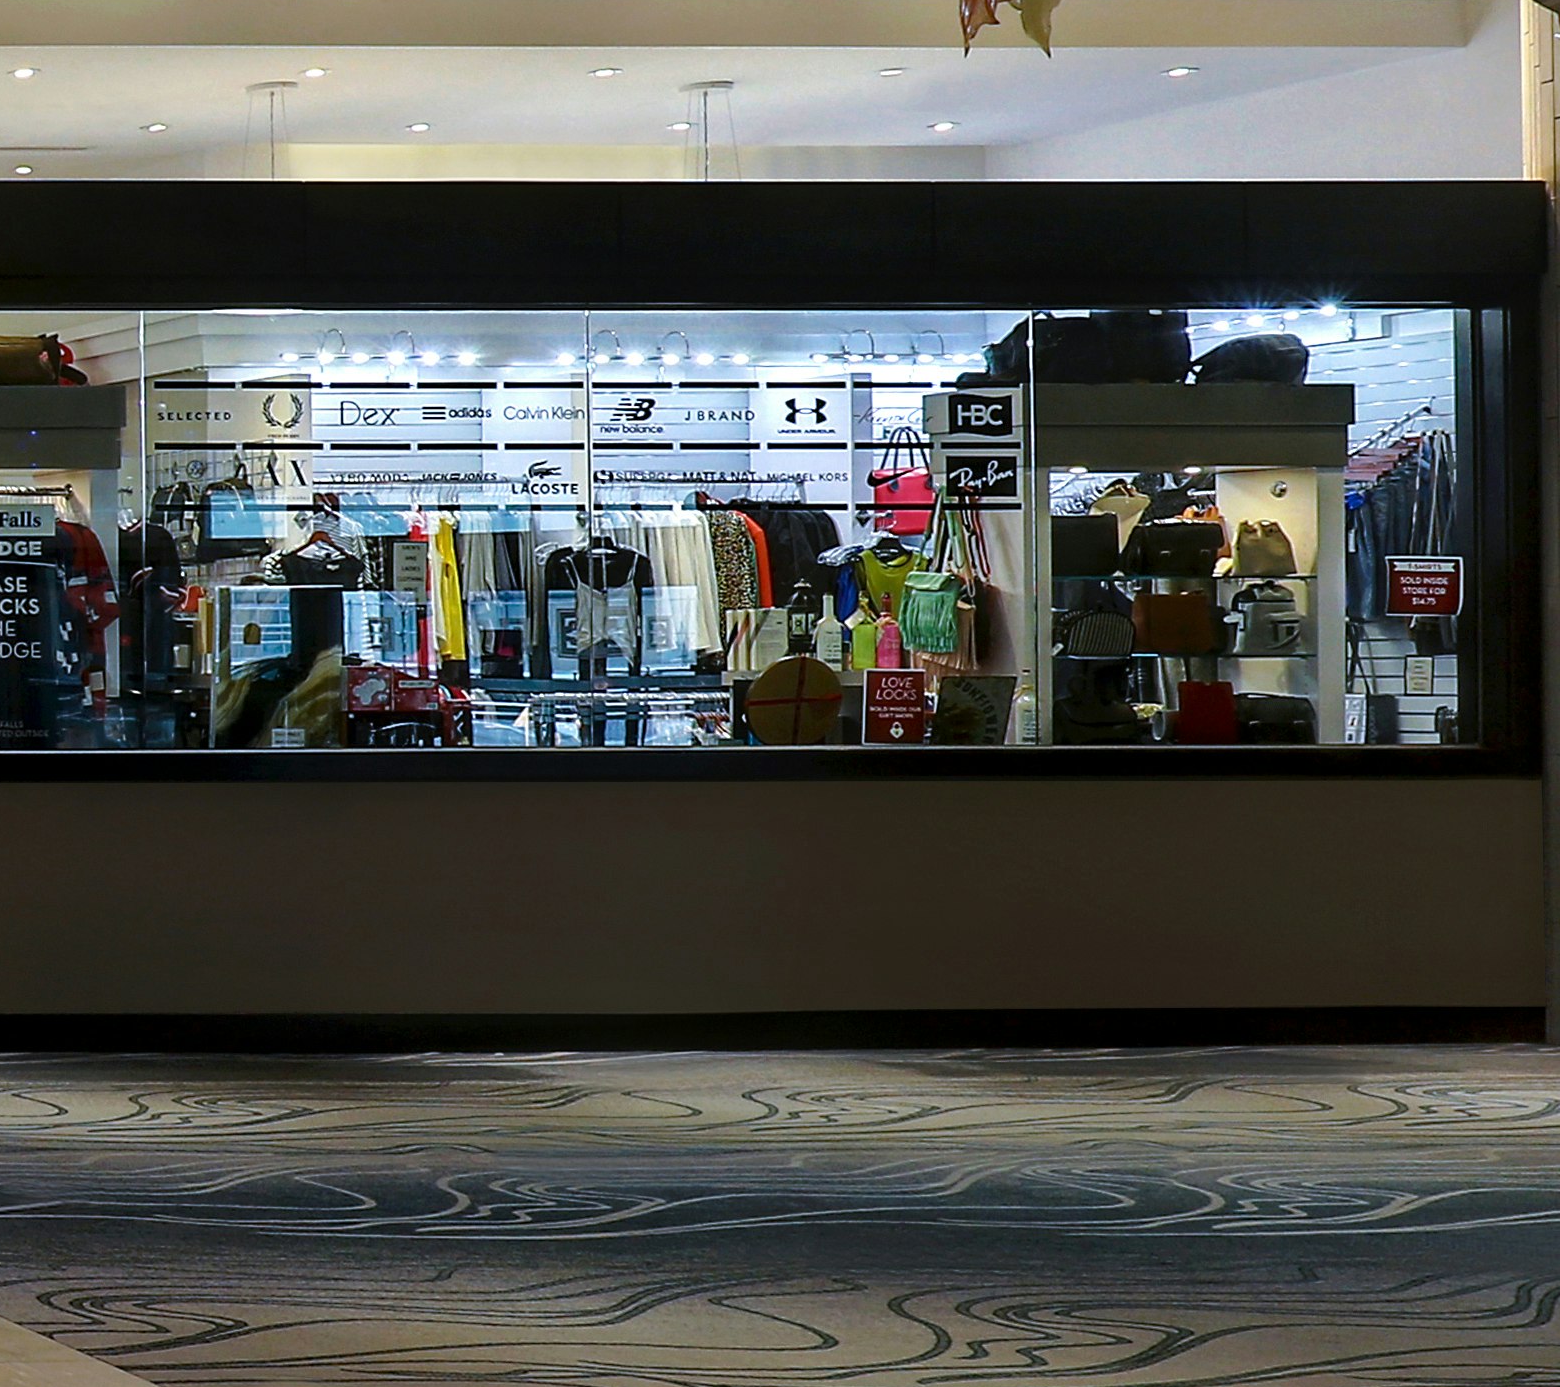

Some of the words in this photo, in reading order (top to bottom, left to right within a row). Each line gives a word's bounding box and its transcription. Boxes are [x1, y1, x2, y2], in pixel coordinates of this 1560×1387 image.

[157, 411, 232, 421] SELECTED
[340, 401, 400, 426] Dex
[448, 406, 492, 418] adidas
[504, 405, 549, 420] Calvin
[552, 405, 585, 420] Klein
[684, 411, 691, 421] J
[698, 411, 755, 421] BRAND
[957, 404, 1004, 426] HBC
[622, 424, 664, 433] balance
[683, 472, 717, 482] MATT
[731, 472, 758, 482] NAT
[767, 473, 815, 482] MICHAEL
[819, 472, 848, 481] KORS
[511, 483, 579, 495] LACOSTE
[1400, 576, 1422, 584] SOLD
[881, 677, 914, 689] LOVE
[876, 689, 917, 701] LOCKS
